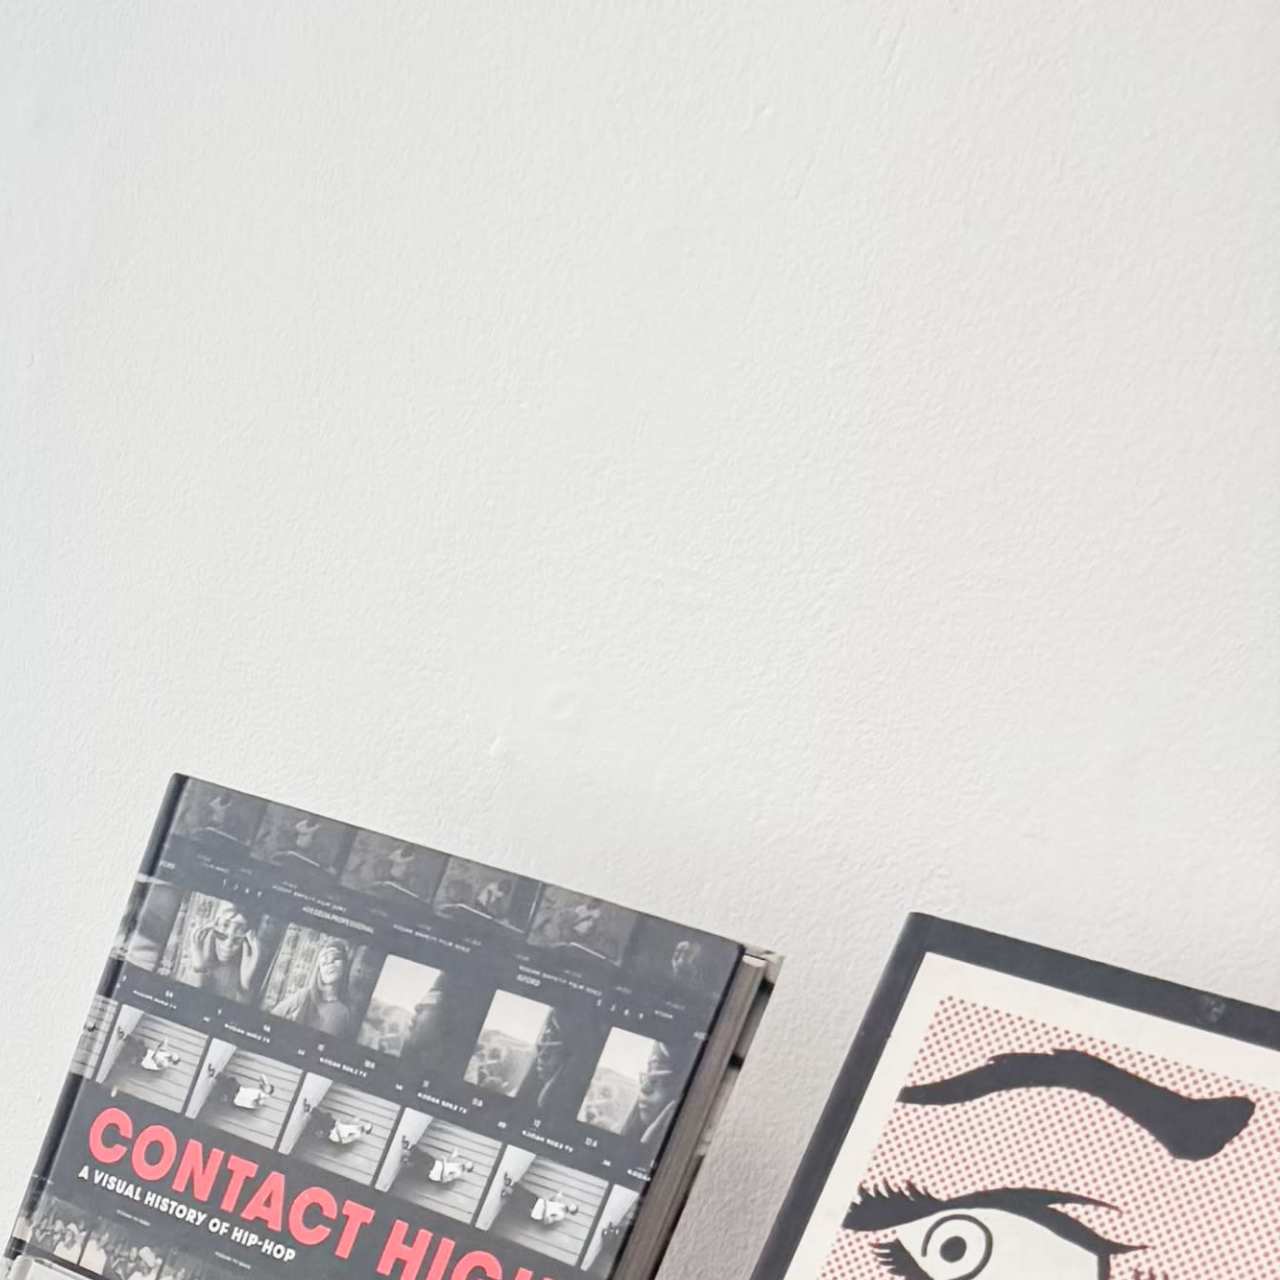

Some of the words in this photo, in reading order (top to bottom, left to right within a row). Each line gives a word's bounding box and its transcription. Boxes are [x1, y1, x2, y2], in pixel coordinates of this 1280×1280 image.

[78, 1164, 91, 1182] A
[92, 1169, 142, 1202] VISUAL
[143, 1189, 206, 1228] HISTORY
[207, 1215, 230, 1237] OF
[231, 1225, 297, 1262] HIP-HOP
[87, 1106, 375, 1260] CONTACT
